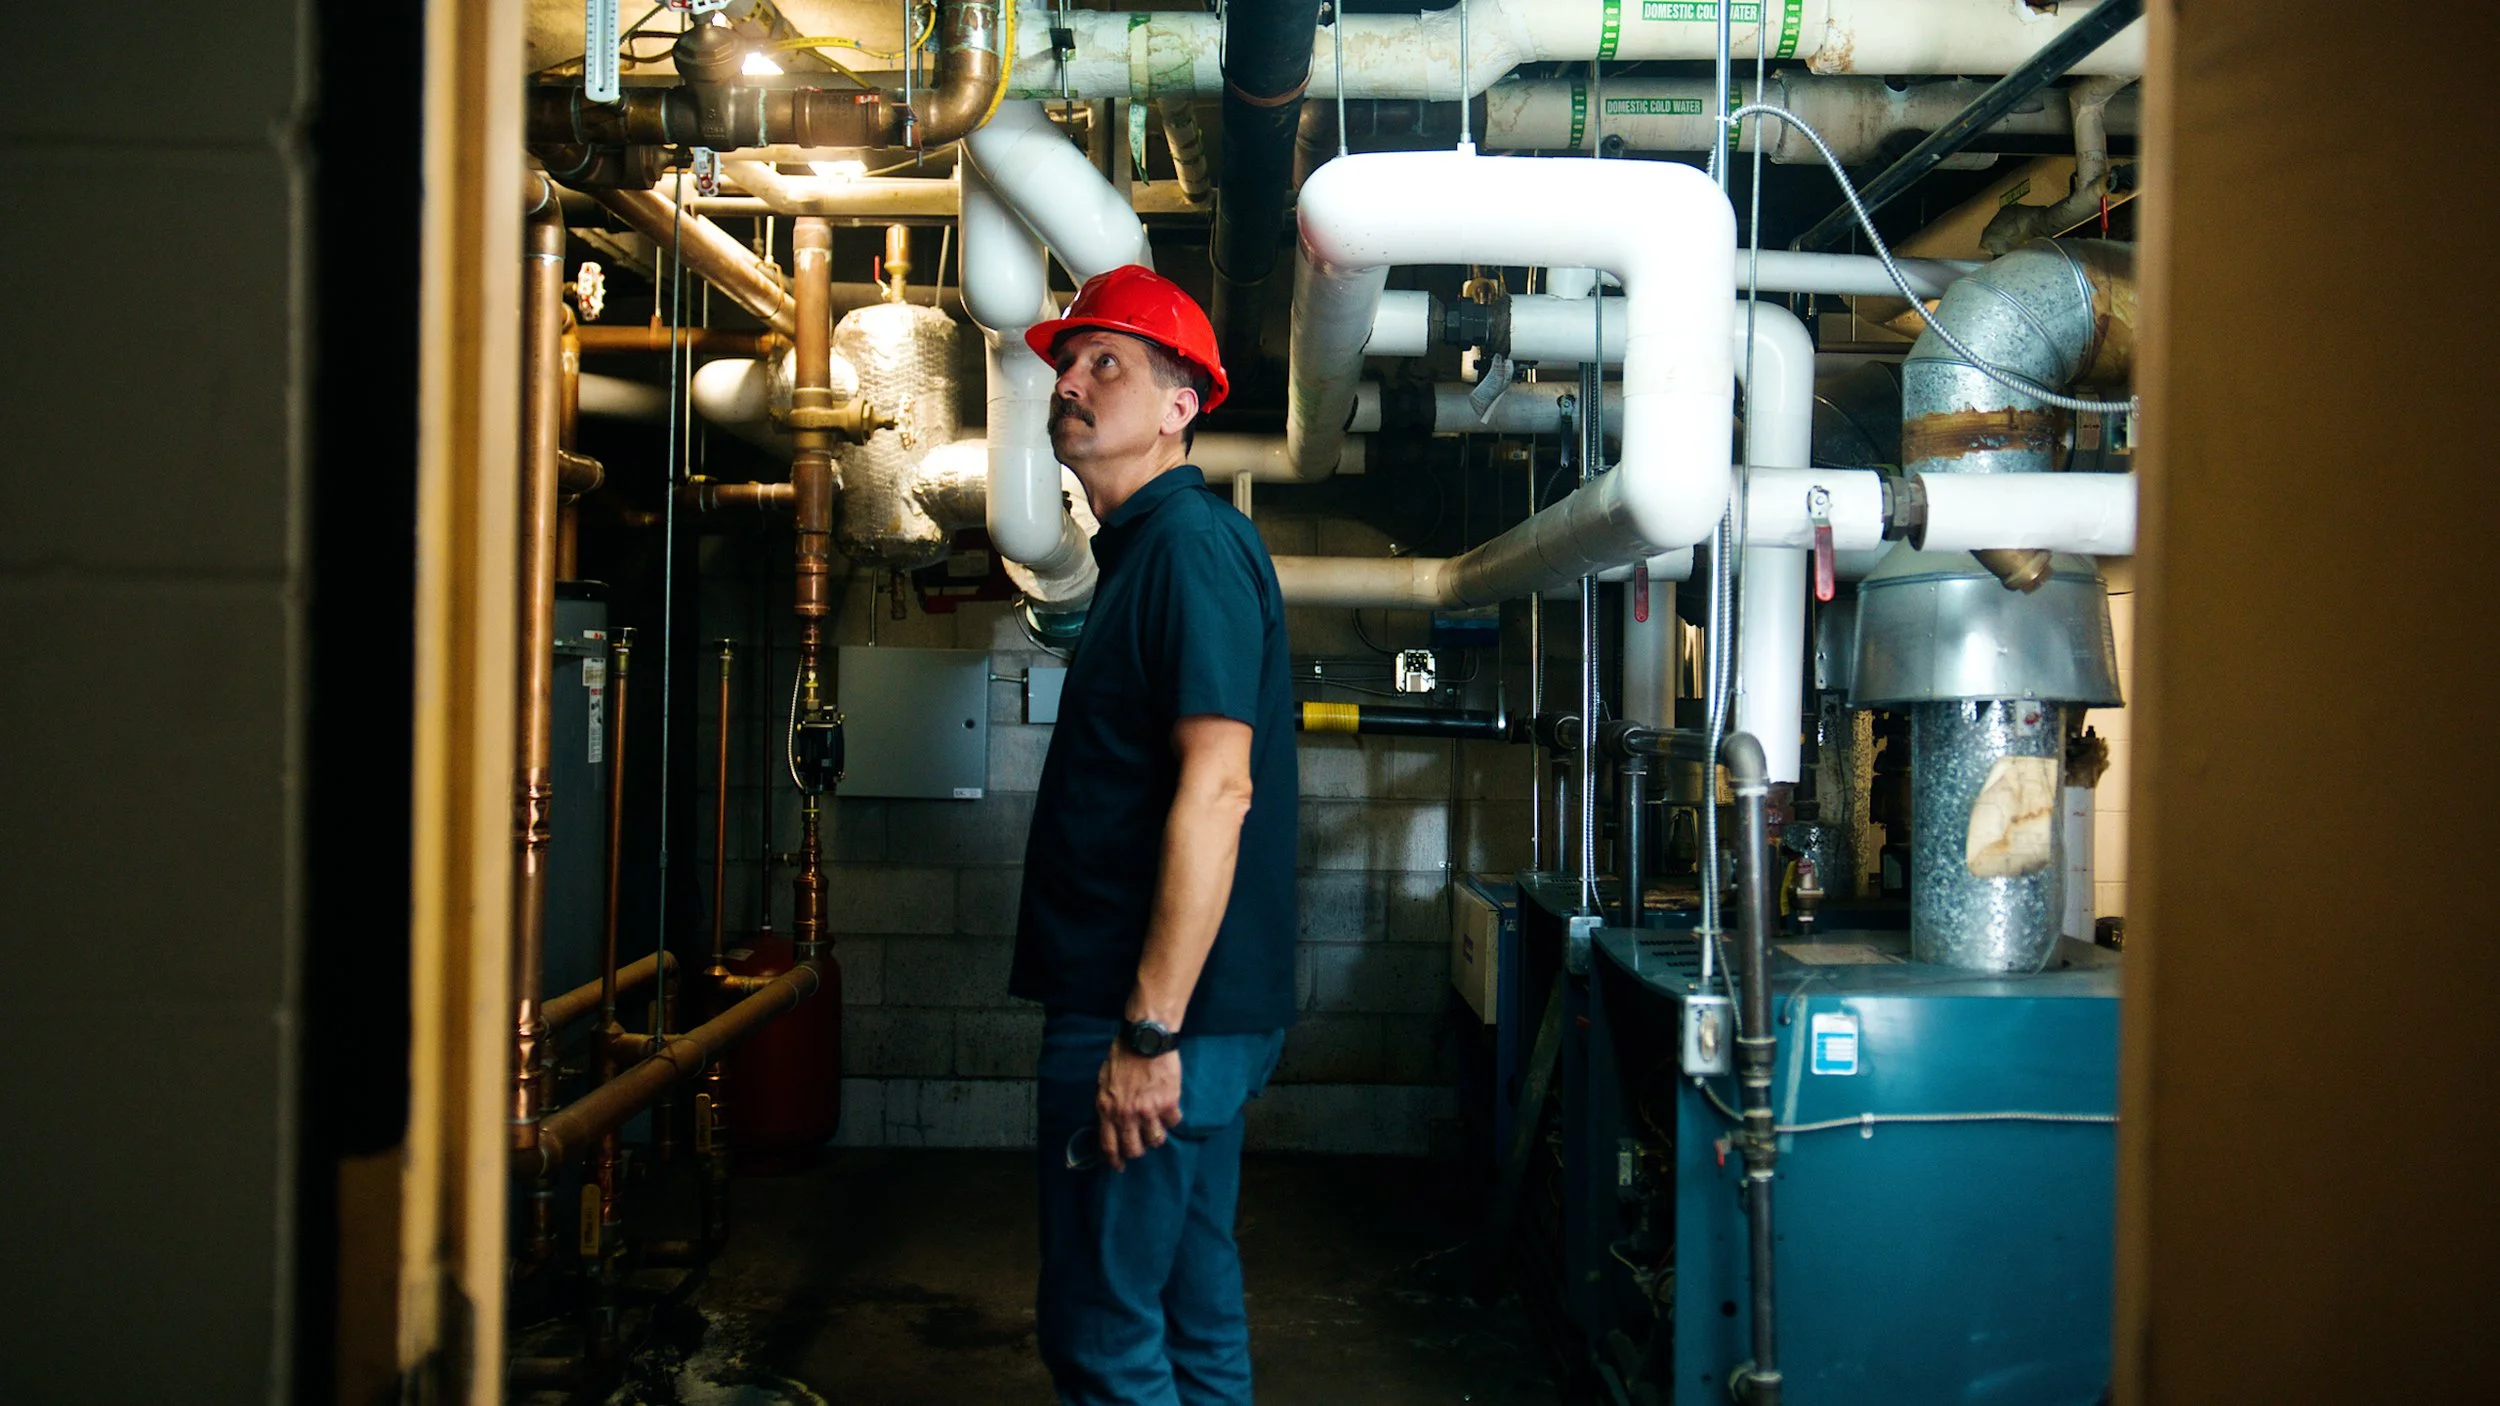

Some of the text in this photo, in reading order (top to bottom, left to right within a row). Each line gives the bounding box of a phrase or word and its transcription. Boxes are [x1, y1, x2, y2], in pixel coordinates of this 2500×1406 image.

[1644, 3, 1694, 19] DOMESTIC
[1607, 100, 1701, 113] DOMESTIC COLD WATER
